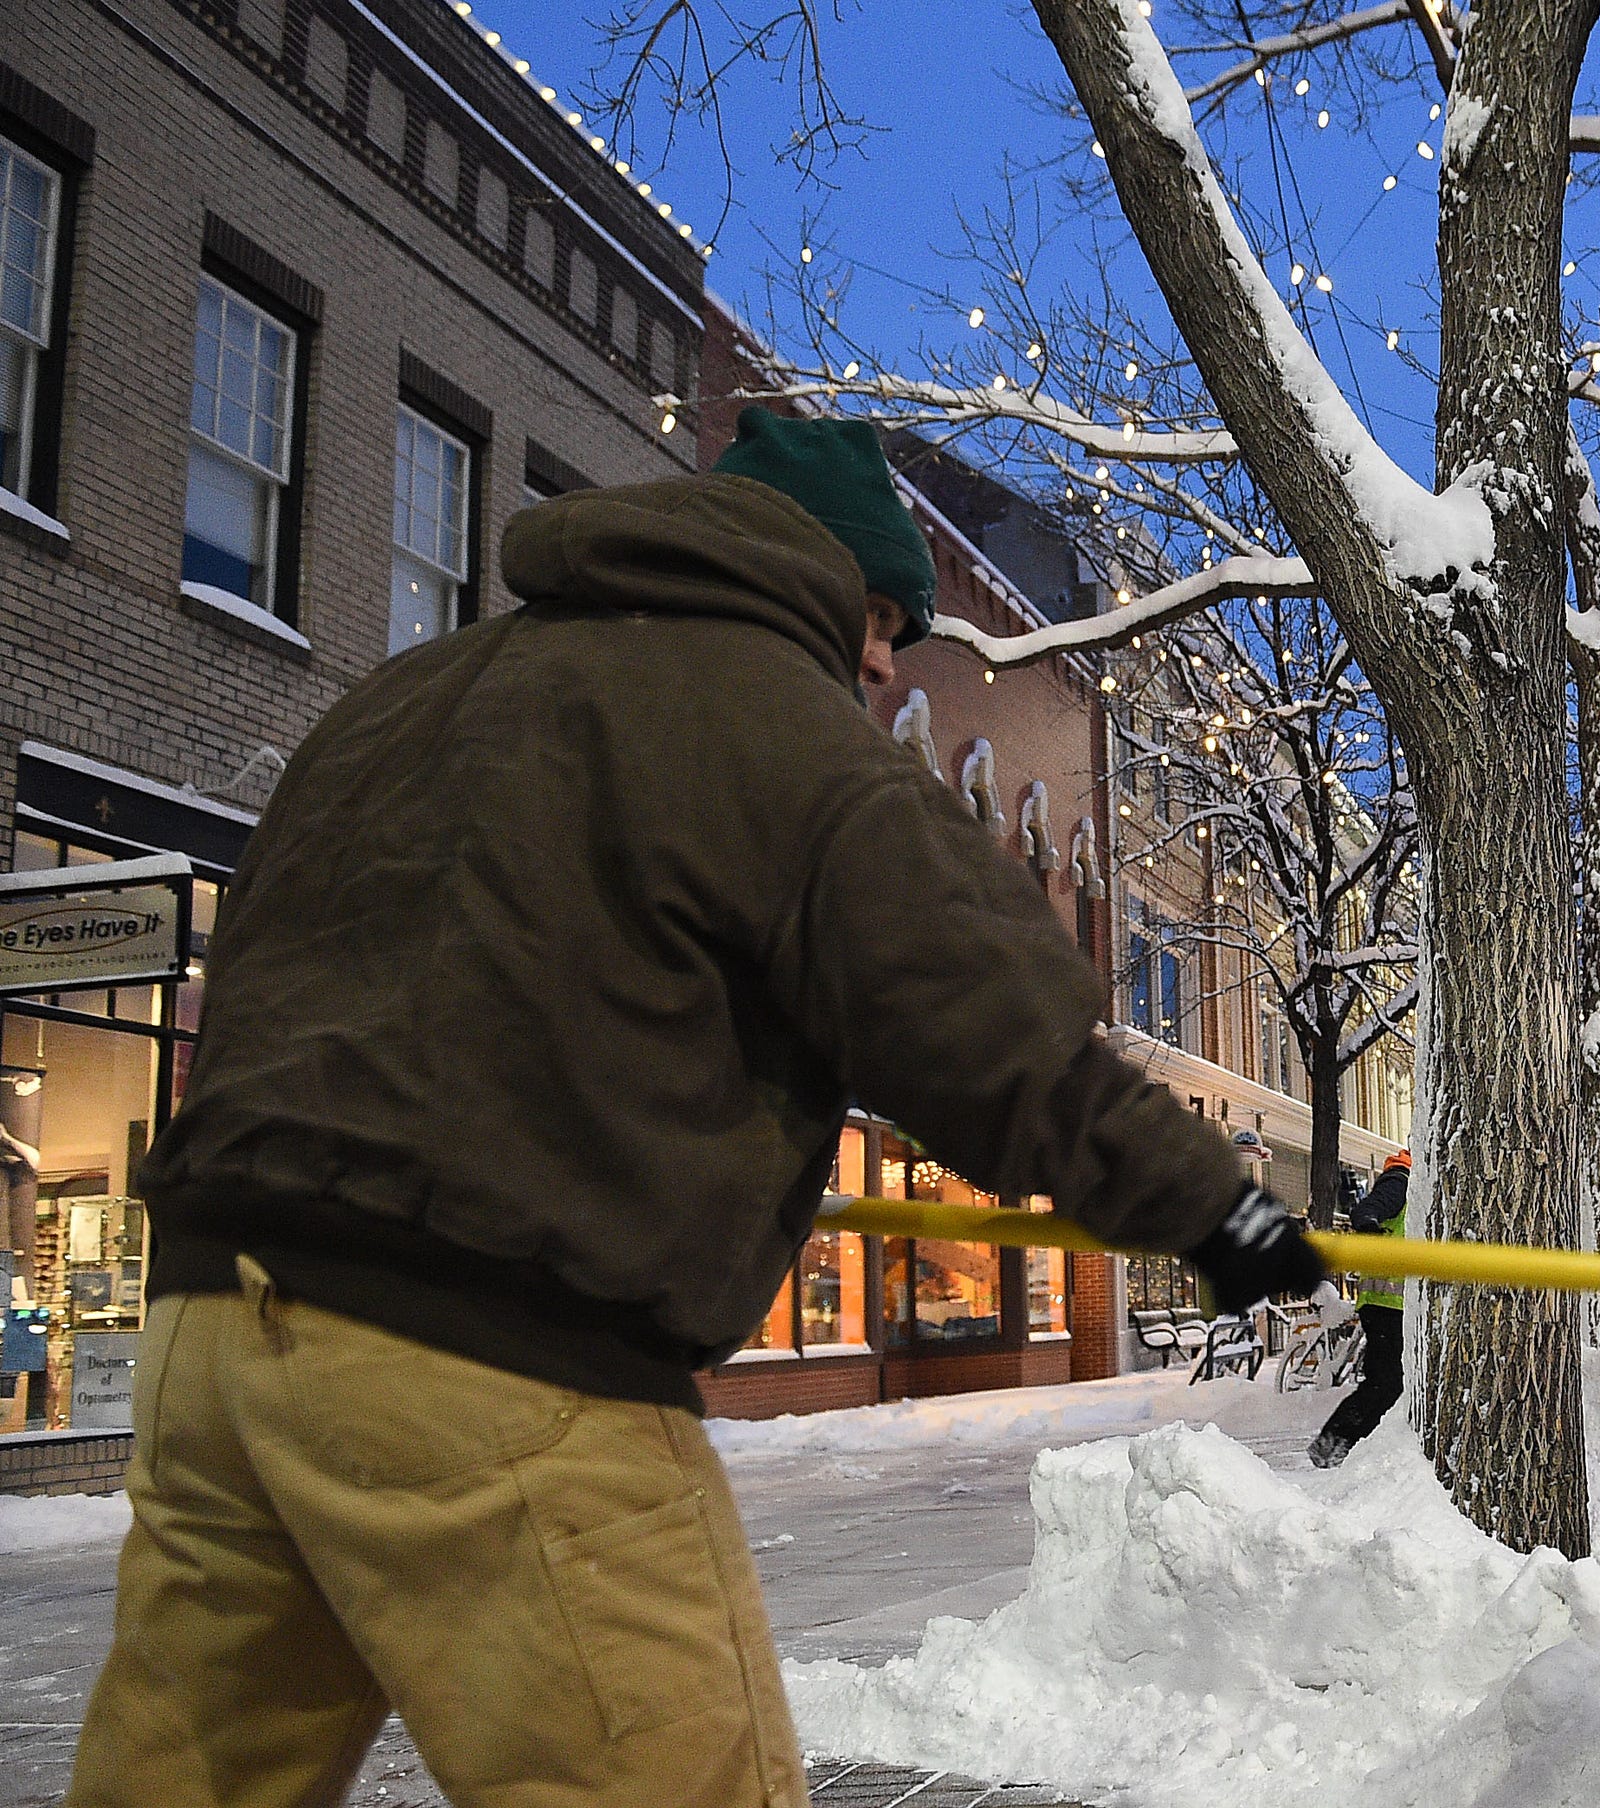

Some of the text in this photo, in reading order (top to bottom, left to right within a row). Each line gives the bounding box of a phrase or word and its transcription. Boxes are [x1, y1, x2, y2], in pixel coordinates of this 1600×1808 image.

[0, 913, 160, 948] e Eyes Have It
